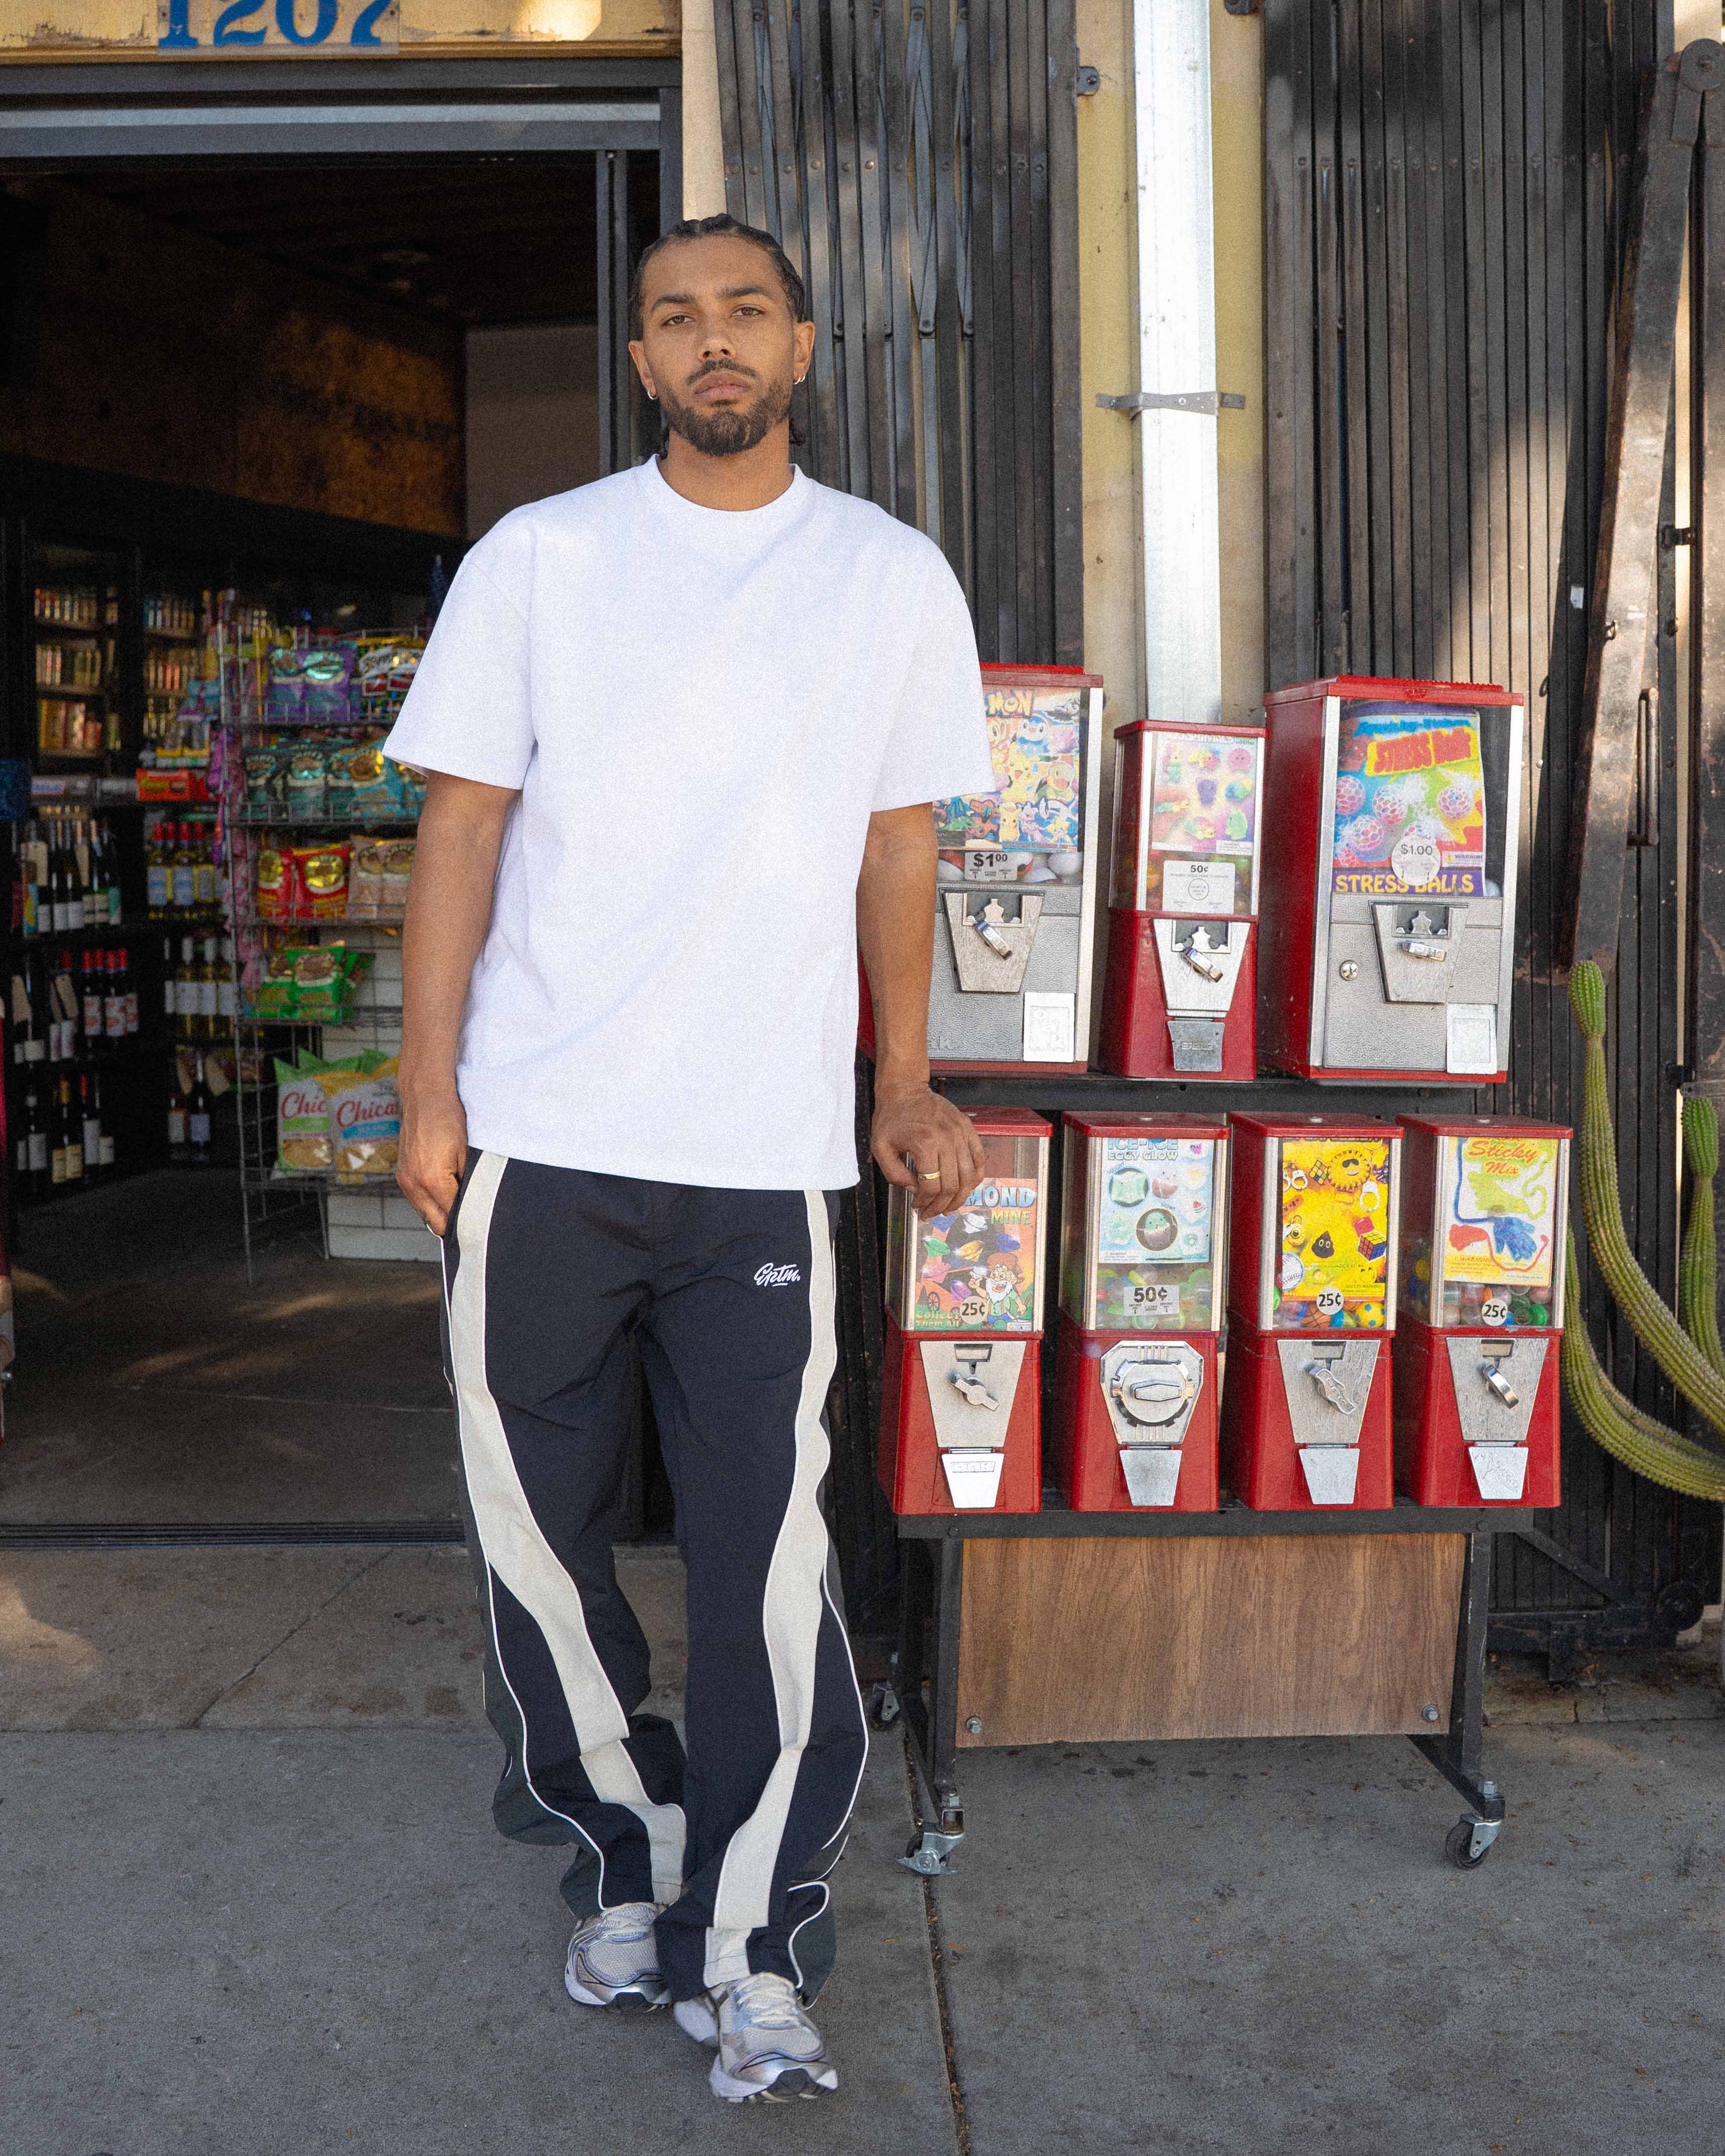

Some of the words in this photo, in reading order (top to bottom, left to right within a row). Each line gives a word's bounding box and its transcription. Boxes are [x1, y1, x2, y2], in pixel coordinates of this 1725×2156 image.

[985, 690, 1034, 716] MON
[1400, 844, 1433, 855] $1.00
[1190, 864, 1209, 873] 50¢
[1335, 874, 1409, 893] STRESS
[1107, 1151, 1140, 1161] EGGY
[1143, 1151, 1178, 1161] GLOW
[1467, 1140, 1538, 1164] Sticky
[1485, 1161, 1520, 1175] Mix
[990, 1209, 1032, 1225] MINE
[1134, 1287, 1168, 1303] 50¢
[1318, 1293, 1341, 1307] 25¢
[961, 1302, 985, 1316] 25¢
[1484, 1304, 1506, 1319] 25¢
